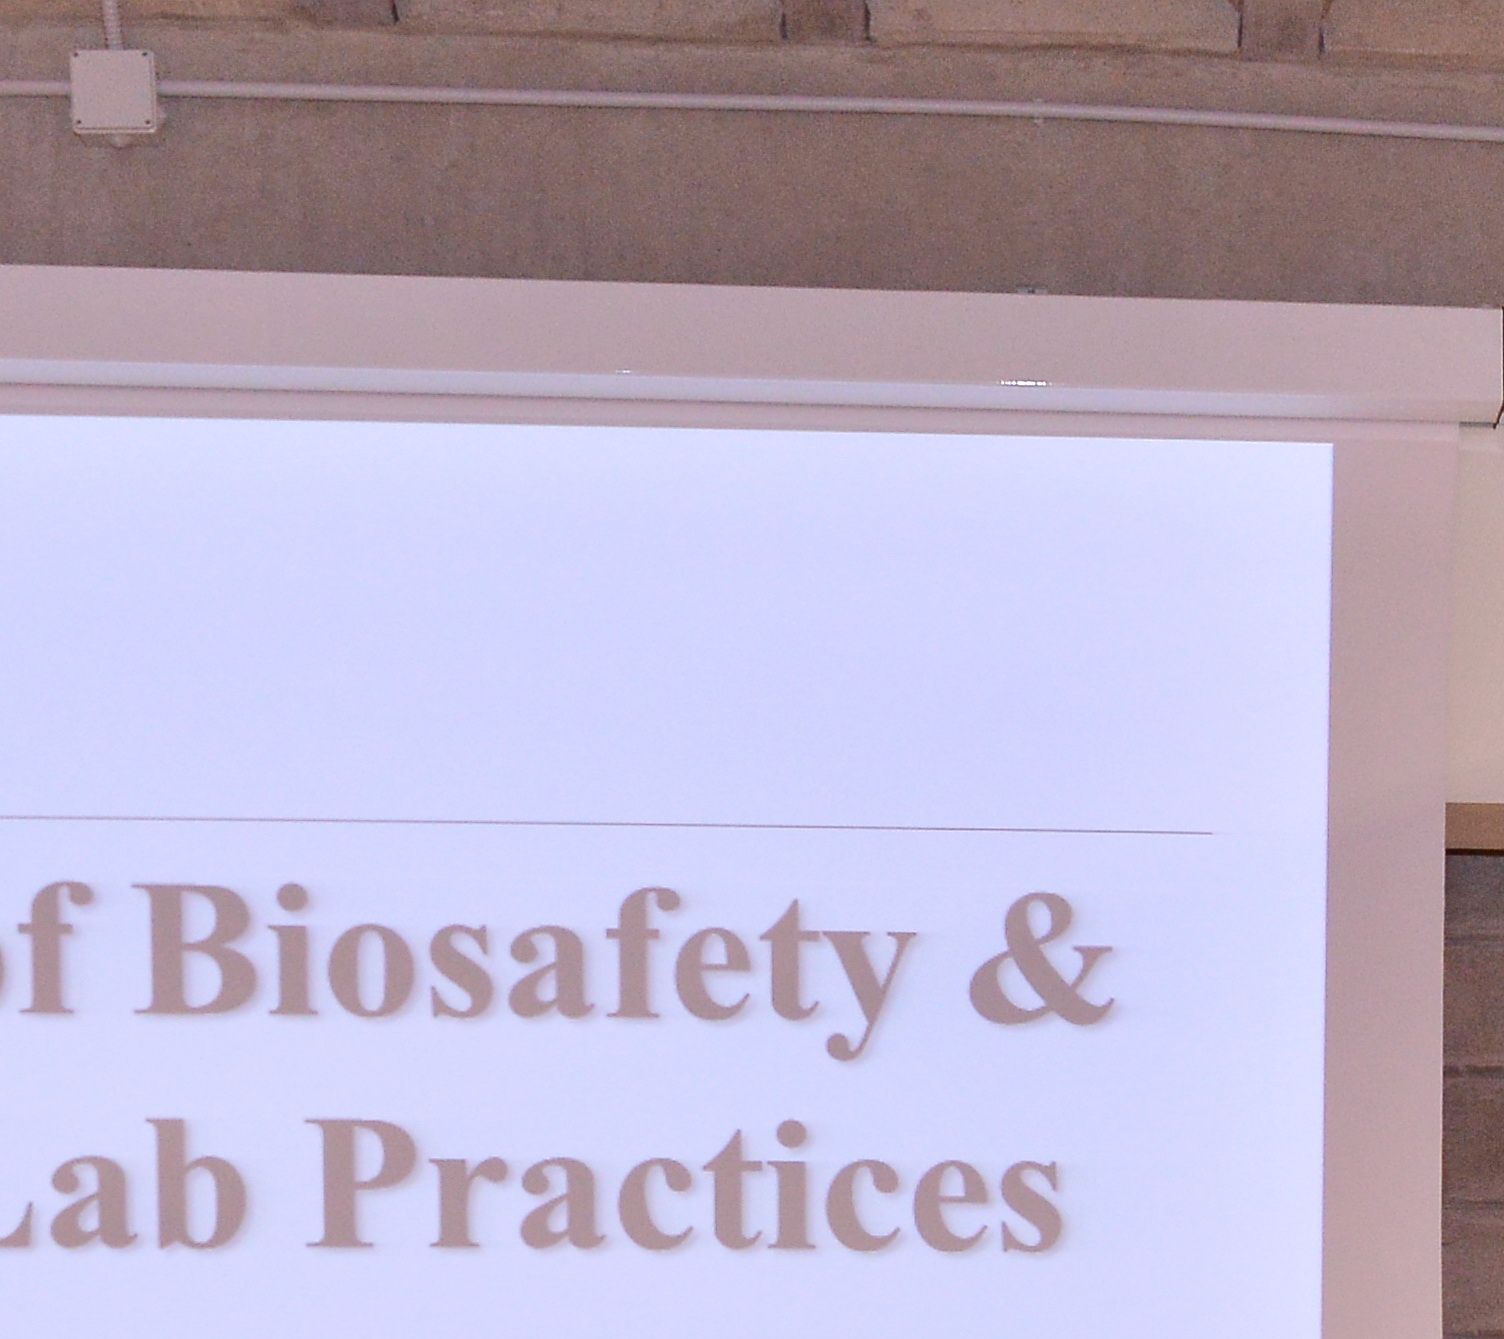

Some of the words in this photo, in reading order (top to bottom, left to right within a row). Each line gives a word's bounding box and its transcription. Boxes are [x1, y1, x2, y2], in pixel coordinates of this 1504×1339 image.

[131, 881, 919, 1064] Biosafety
[967, 891, 1116, 1028] &
[304, 1117, 1066, 1255] Practices
